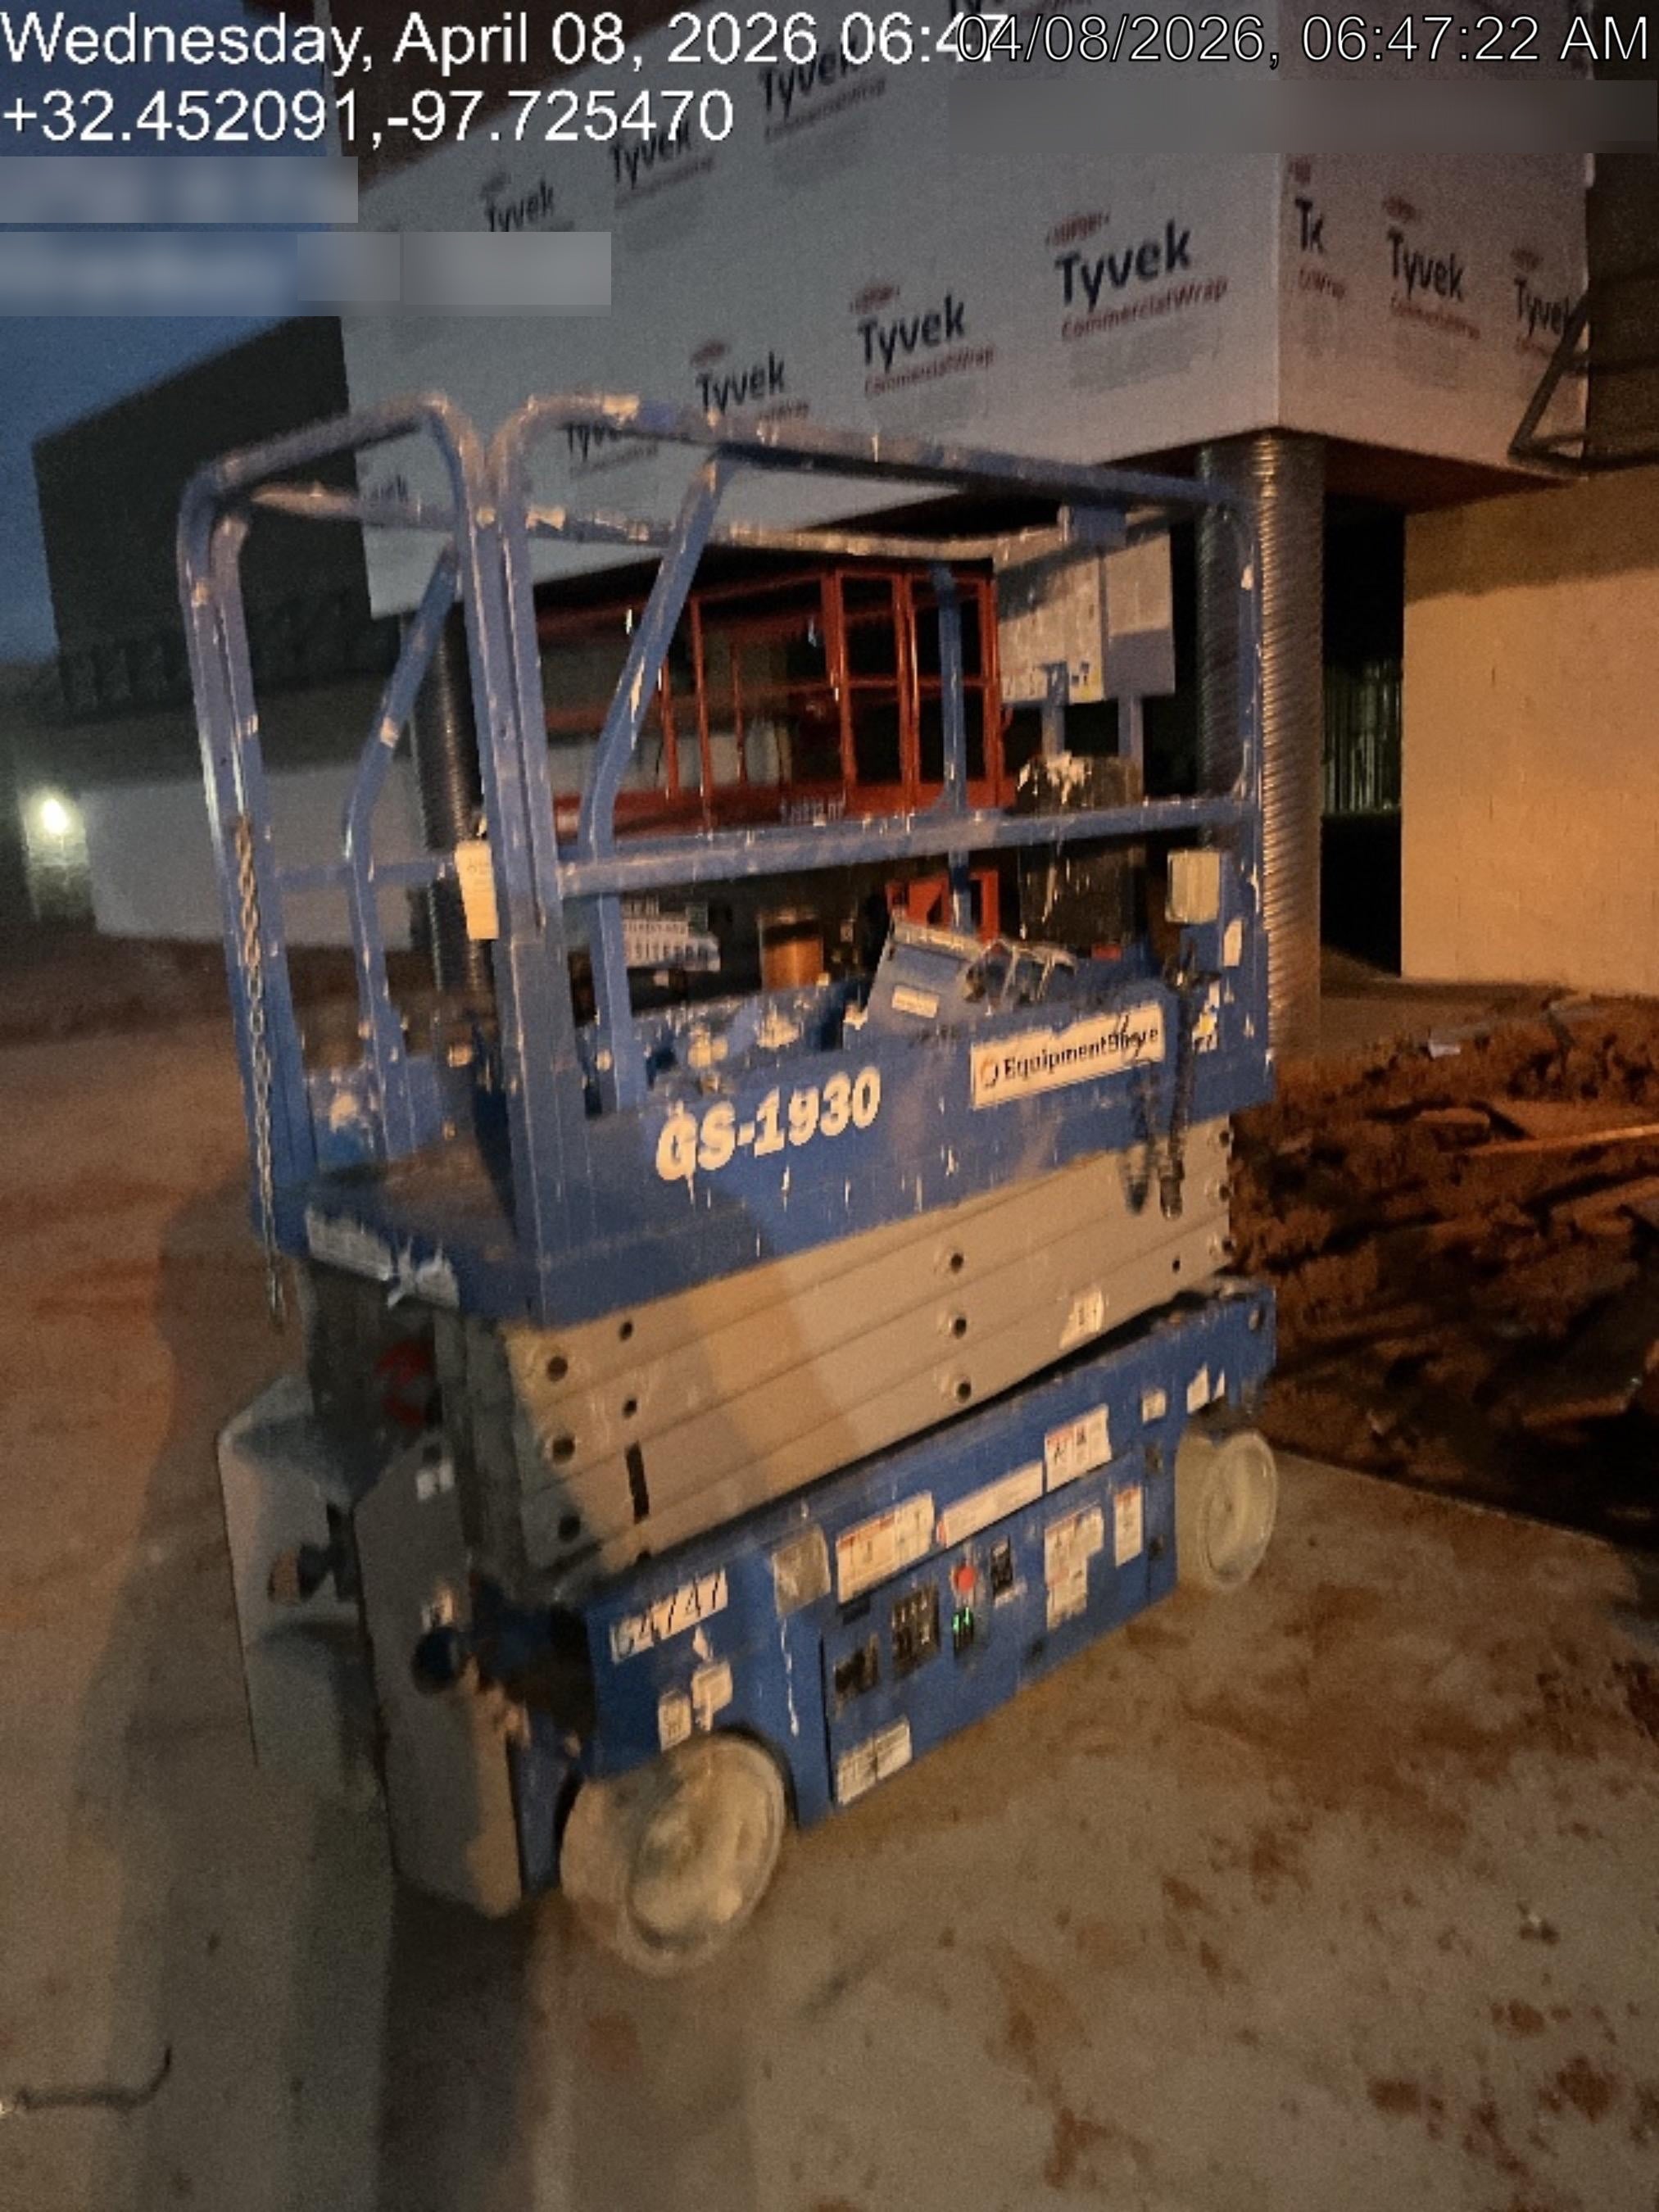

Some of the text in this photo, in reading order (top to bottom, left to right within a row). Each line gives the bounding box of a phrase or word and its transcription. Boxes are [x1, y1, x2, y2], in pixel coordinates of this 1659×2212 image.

[1054, 218, 1191, 315] Tyvek
[1387, 224, 1464, 302] Tyvek
[857, 292, 966, 374] Tyvek
[695, 350, 786, 416] Tyvek
[655, 1065, 882, 1181] GS-1930
